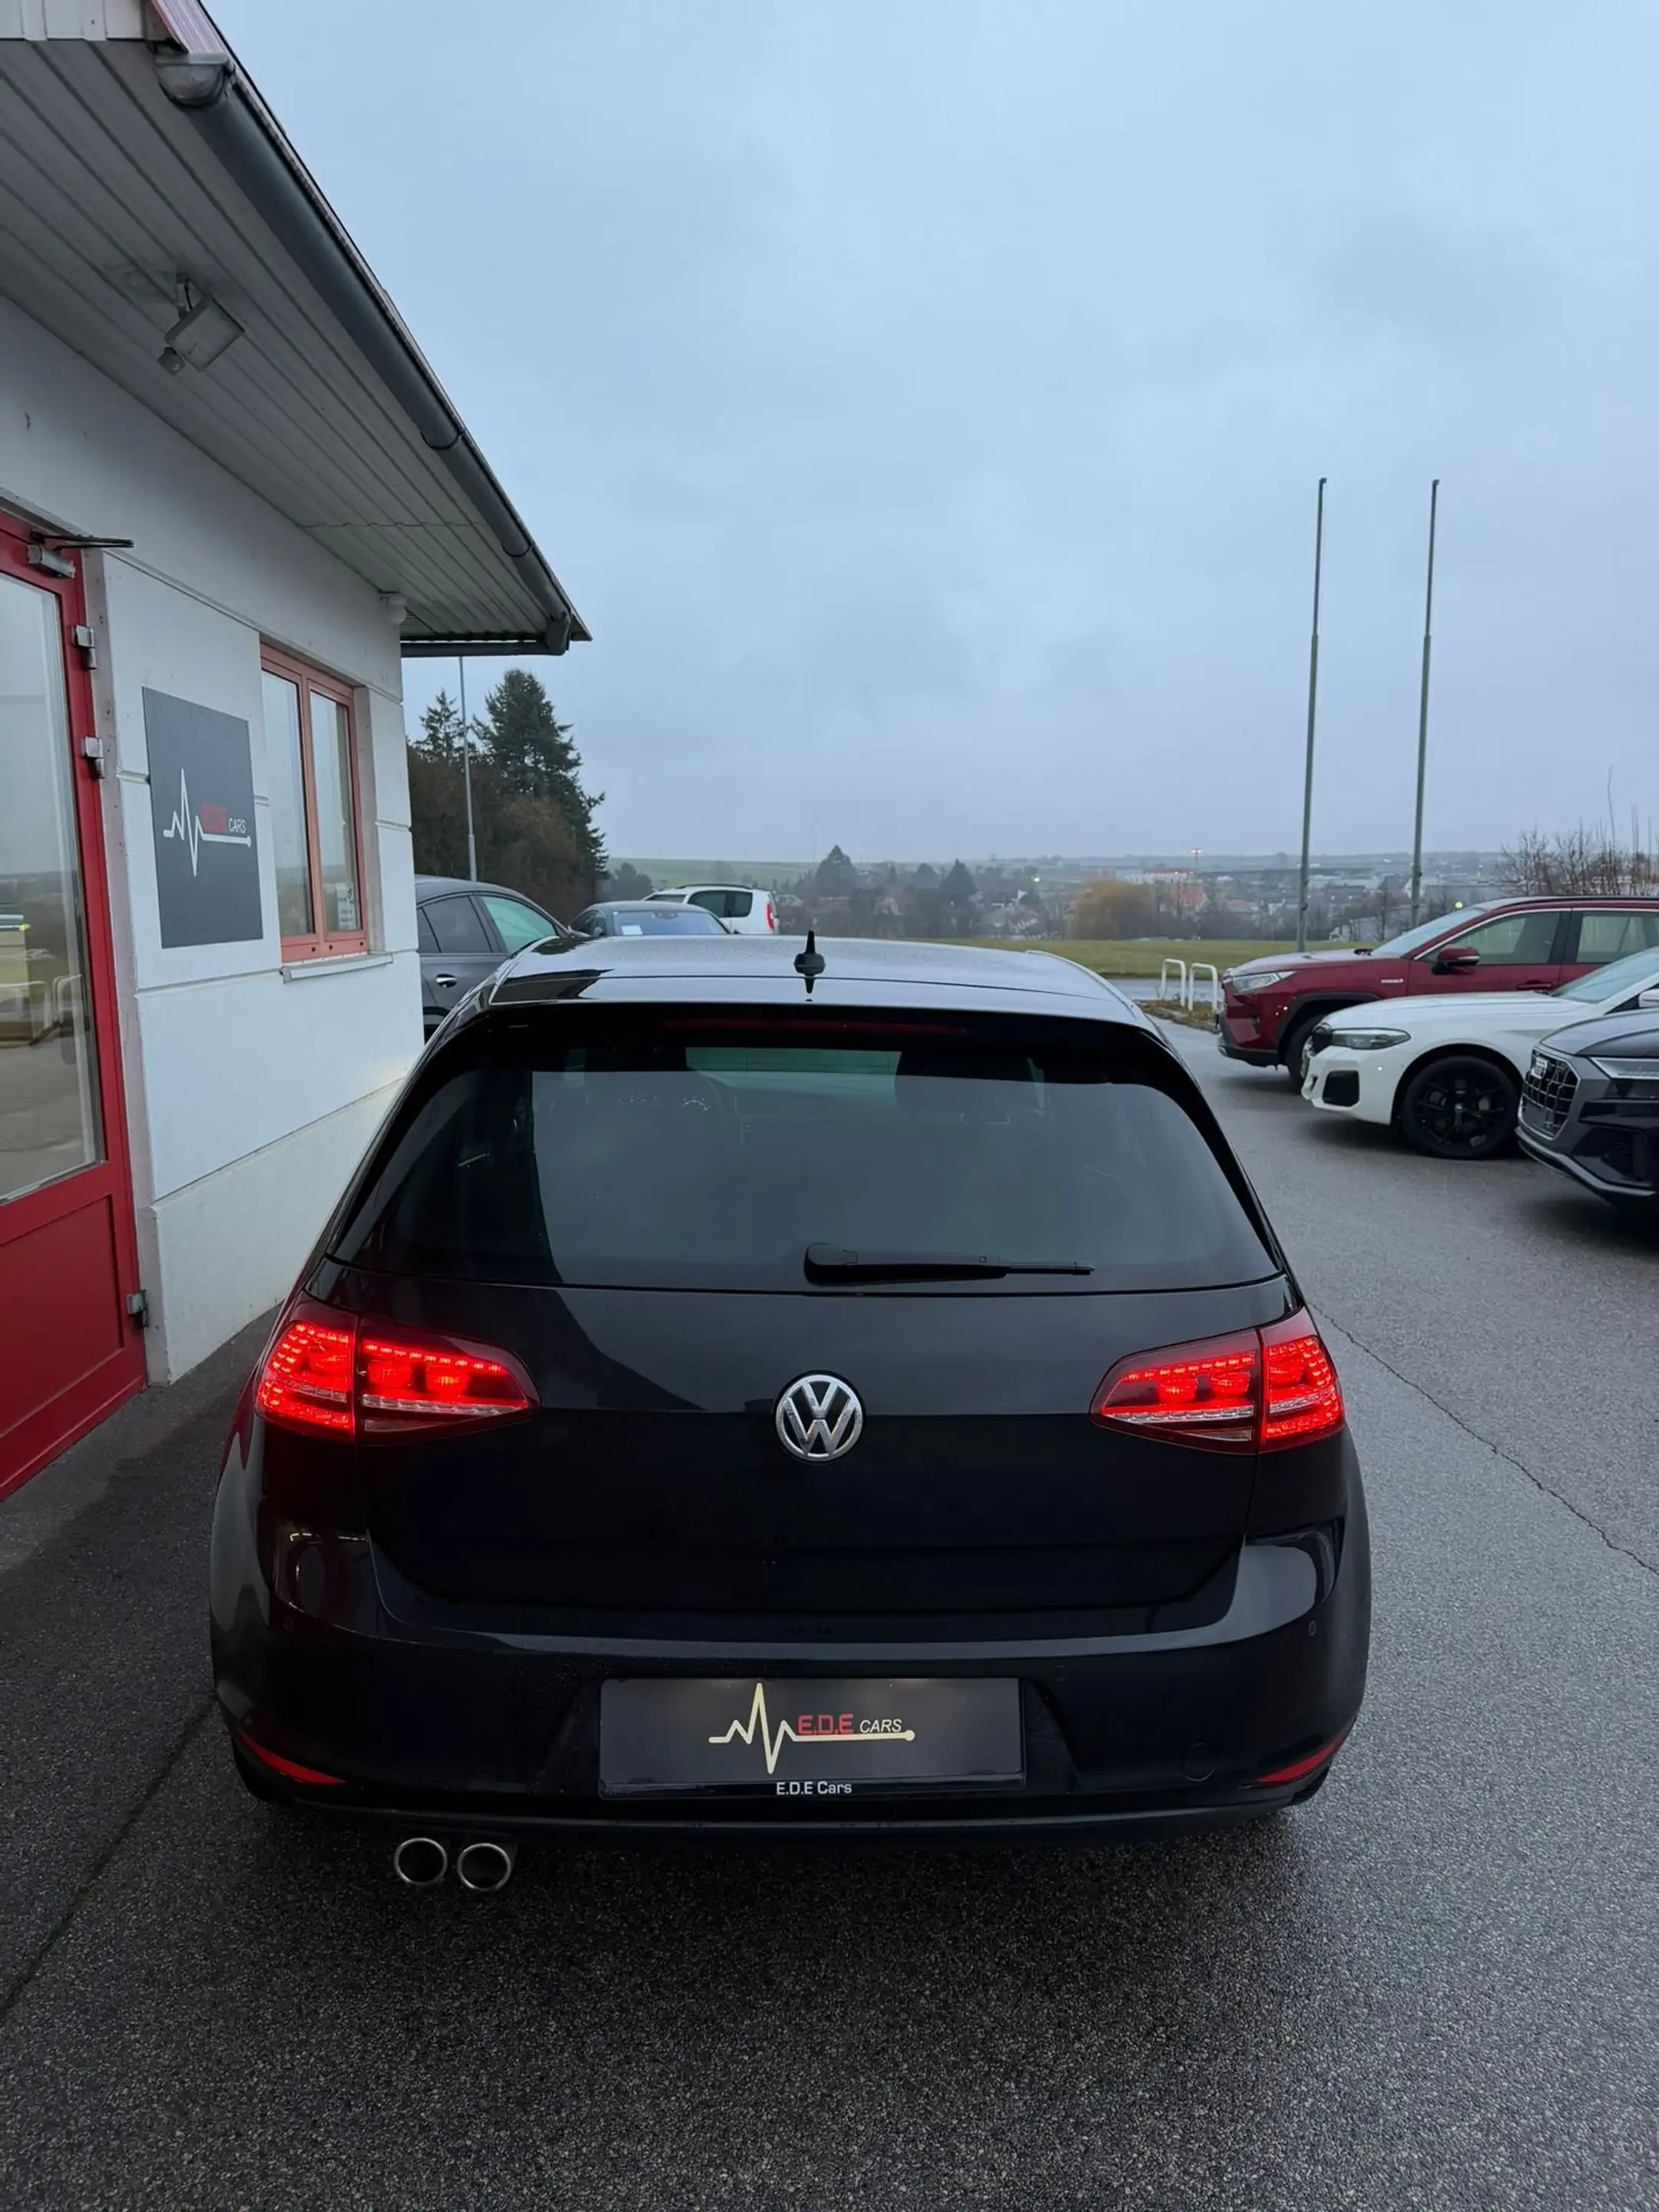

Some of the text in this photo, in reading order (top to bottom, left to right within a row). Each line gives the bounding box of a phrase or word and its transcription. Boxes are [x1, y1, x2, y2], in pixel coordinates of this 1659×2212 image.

[228, 817, 246, 833] CARS
[779, 1377, 860, 1459] VW
[798, 1714, 902, 1734] E.D.E CARS
[776, 1781, 853, 1795] E.D.E Cars
